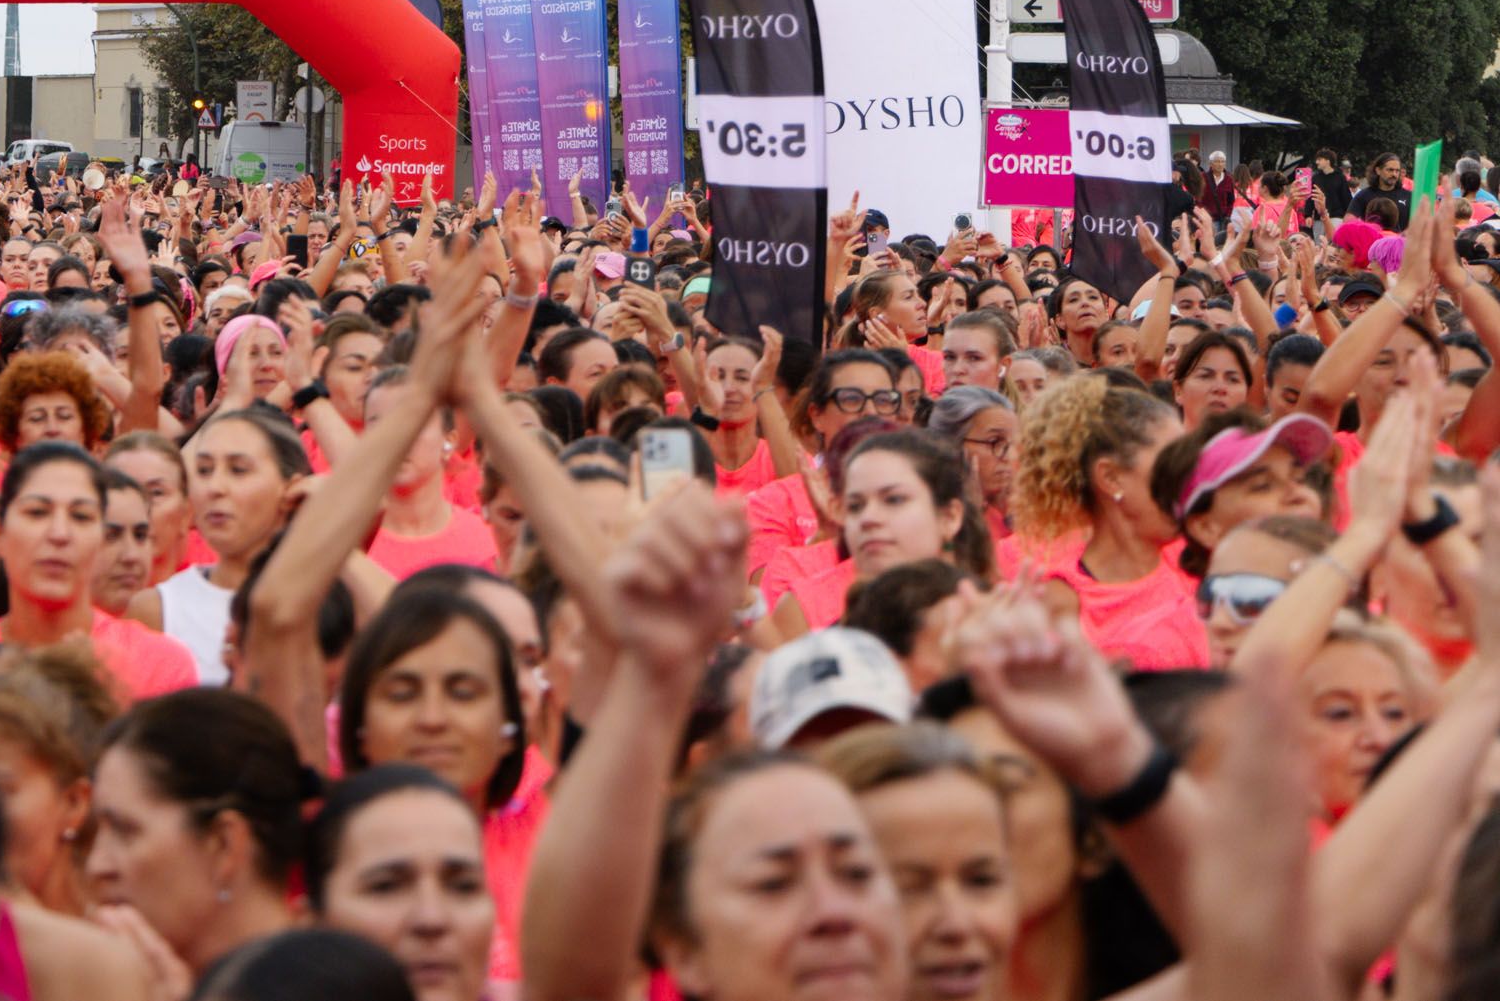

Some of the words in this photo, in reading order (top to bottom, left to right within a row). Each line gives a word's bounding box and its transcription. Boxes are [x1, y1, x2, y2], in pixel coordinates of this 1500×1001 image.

[826, 95, 965, 135] OYSHO
[379, 134, 427, 153] Sports
[373, 159, 445, 175] Santander
